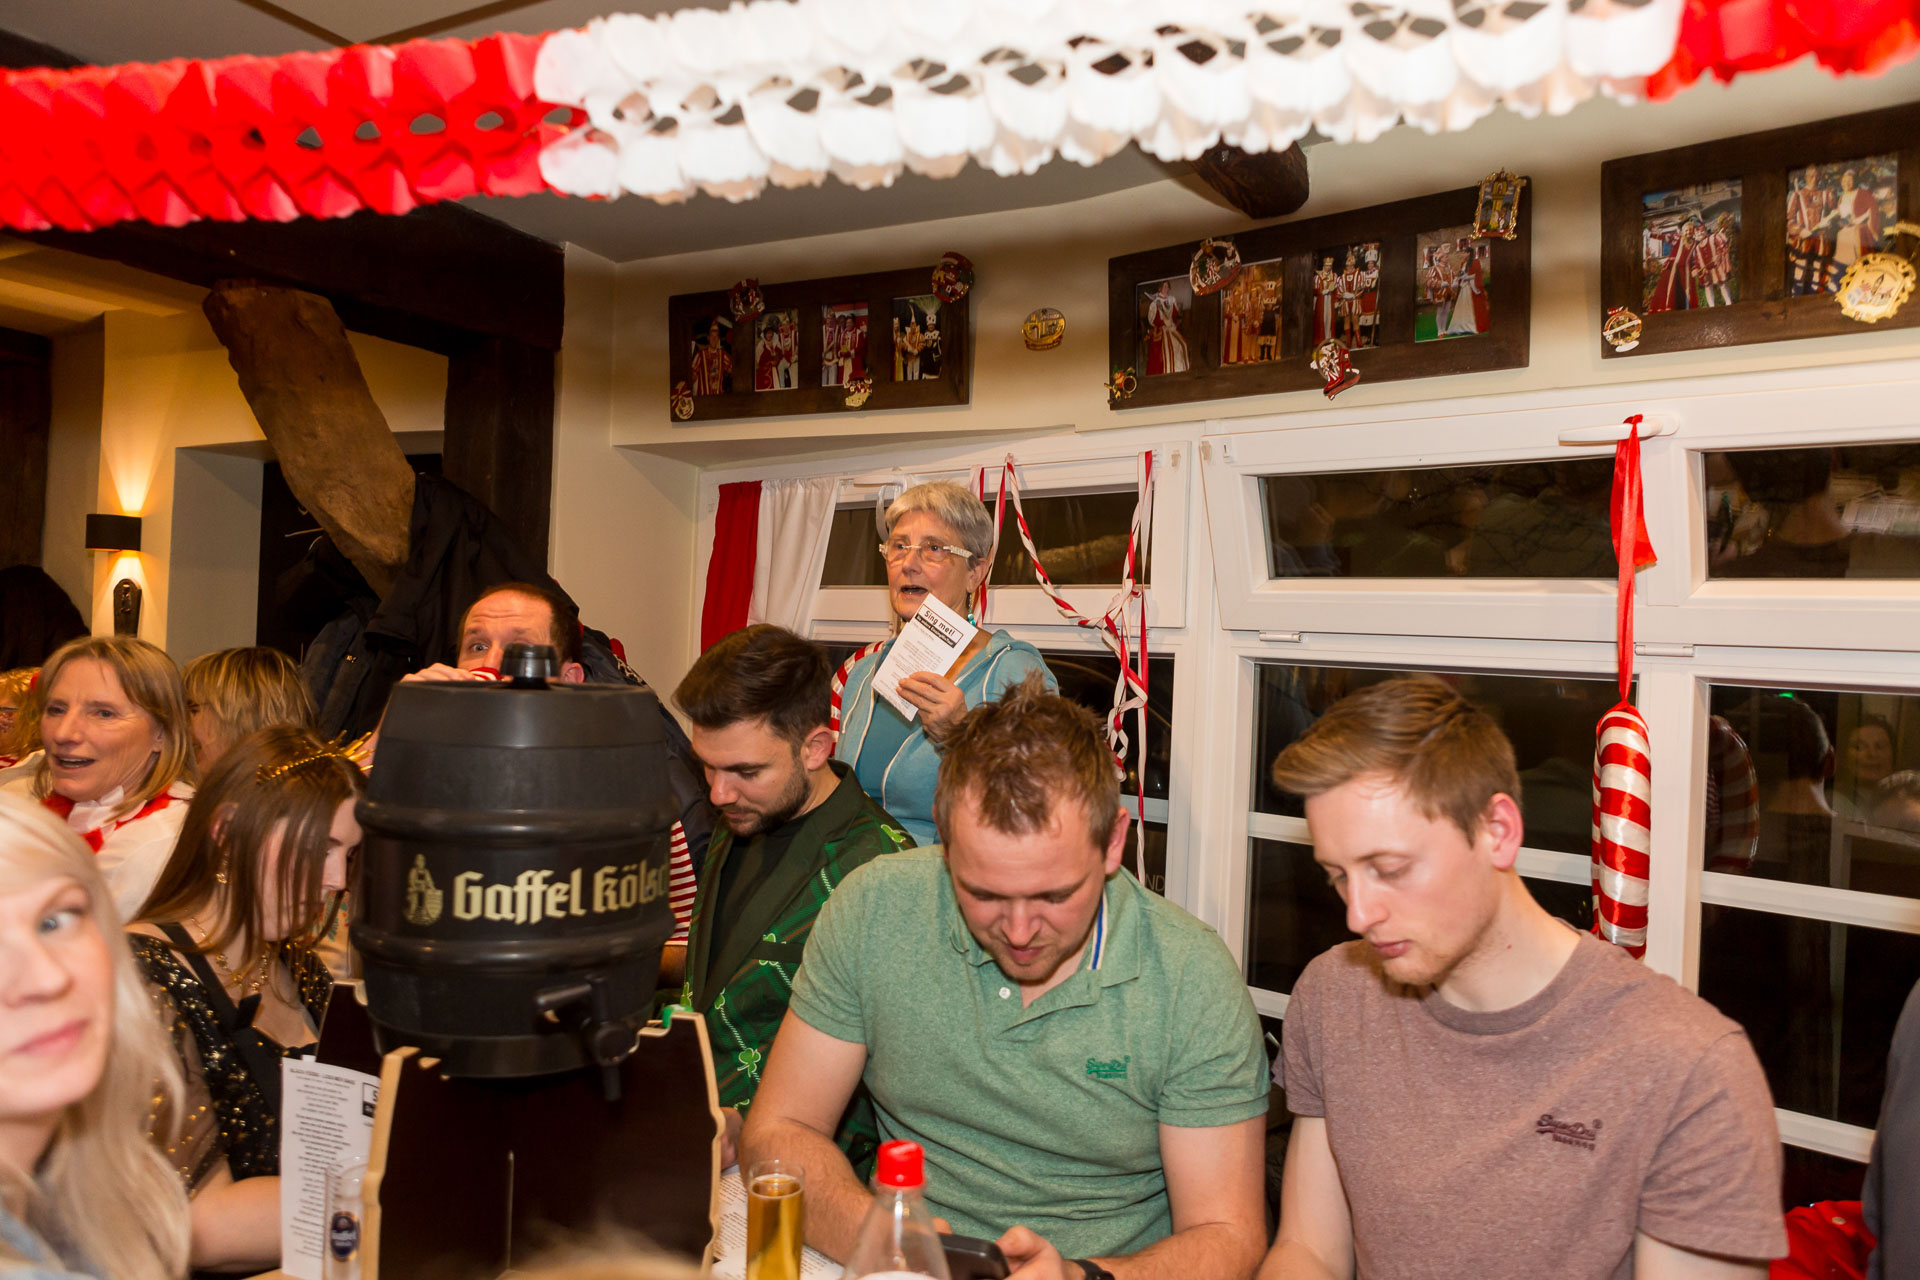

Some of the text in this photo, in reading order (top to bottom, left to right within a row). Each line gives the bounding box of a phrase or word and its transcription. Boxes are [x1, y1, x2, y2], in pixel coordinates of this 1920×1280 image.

[924, 610, 939, 625] Sing
[938, 622, 956, 636] met!
[452, 859, 670, 925] Gaffel Kölsc
